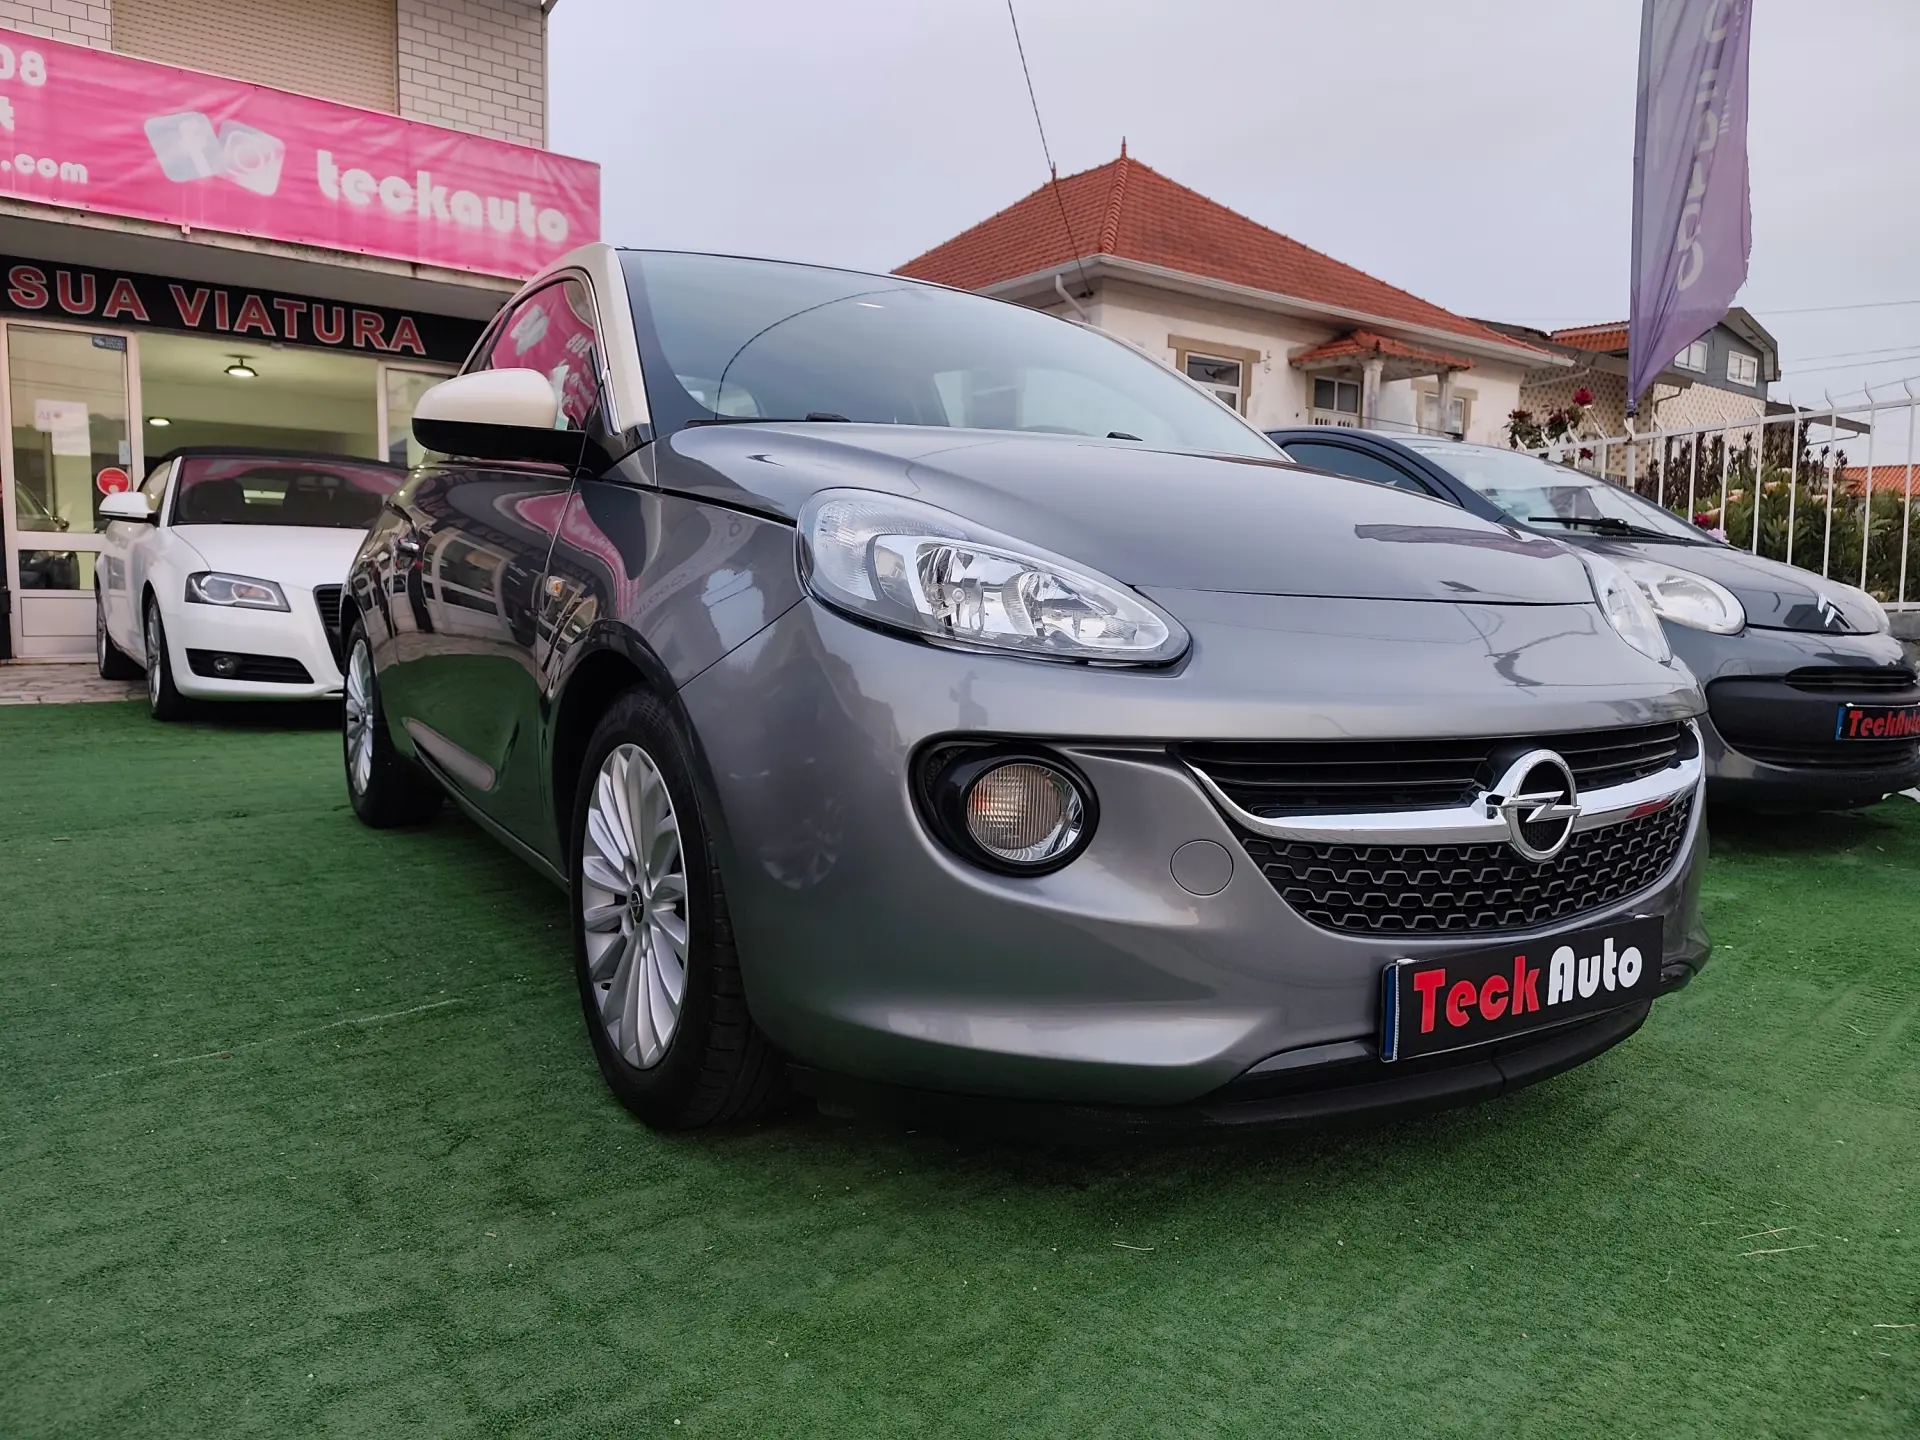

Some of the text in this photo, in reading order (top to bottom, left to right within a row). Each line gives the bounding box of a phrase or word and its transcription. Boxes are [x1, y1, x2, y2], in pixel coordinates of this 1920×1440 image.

[316, 148, 569, 243] teckauto
[7, 264, 428, 356] SUA VIATURA
